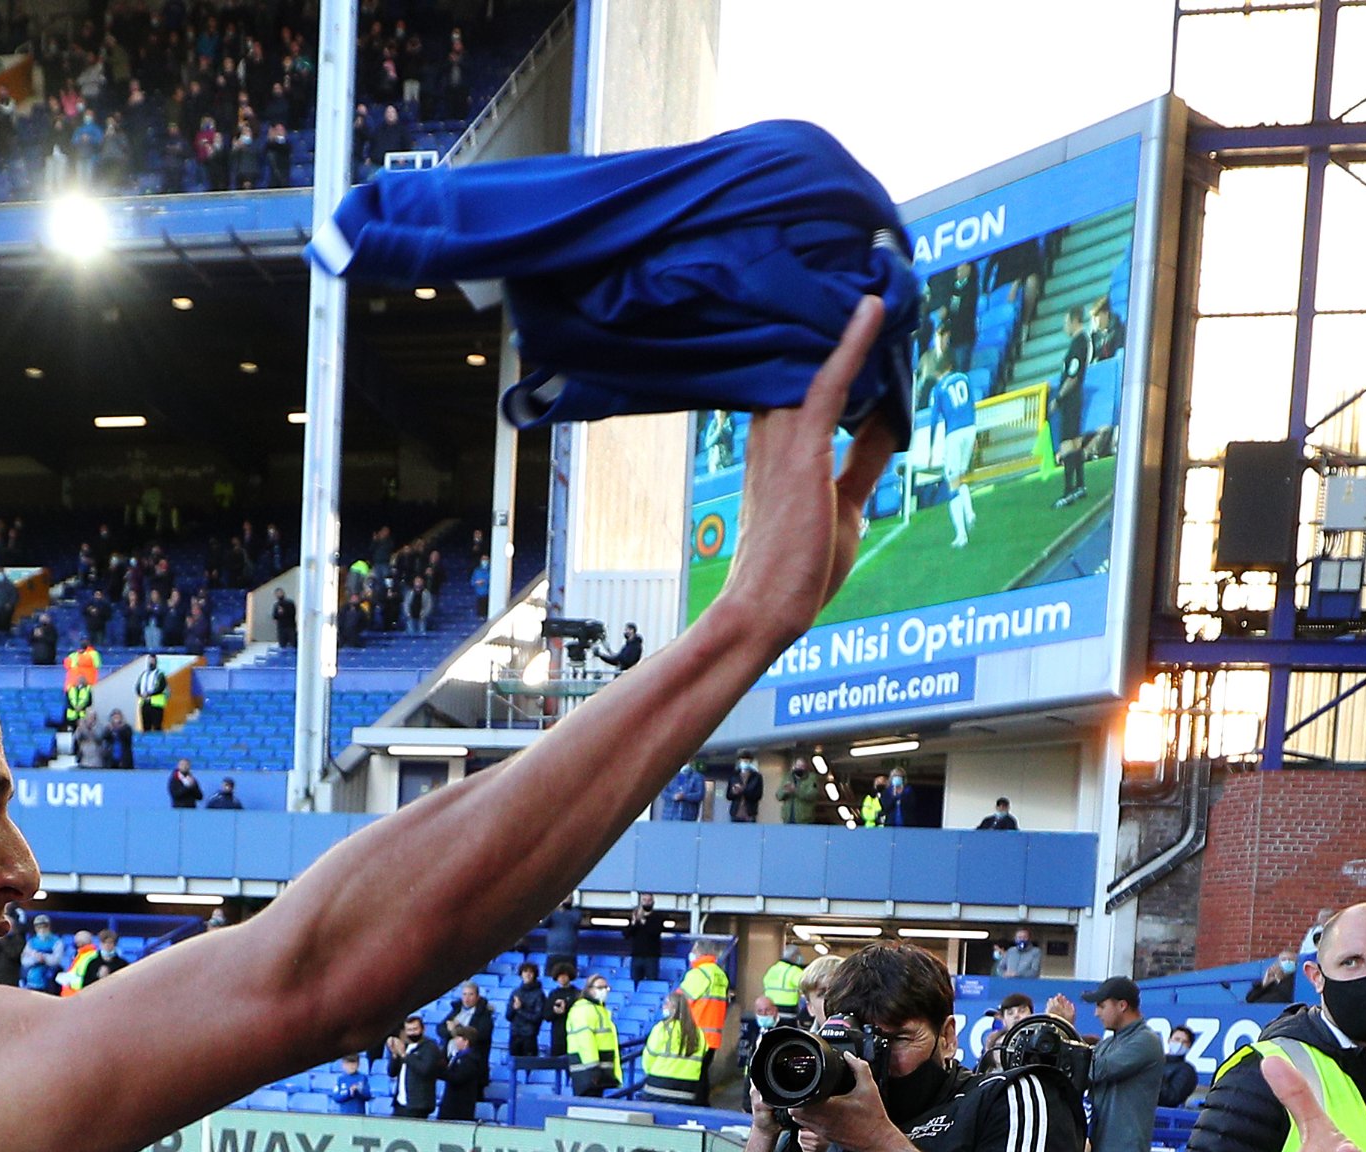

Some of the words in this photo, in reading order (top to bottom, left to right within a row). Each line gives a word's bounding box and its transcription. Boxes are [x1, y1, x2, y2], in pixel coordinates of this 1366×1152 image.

[830, 622, 890, 667] Nisi
[898, 600, 1071, 662] Optimum
[788, 670, 960, 715] evertonfc.com
[46, 782, 103, 806] USM
